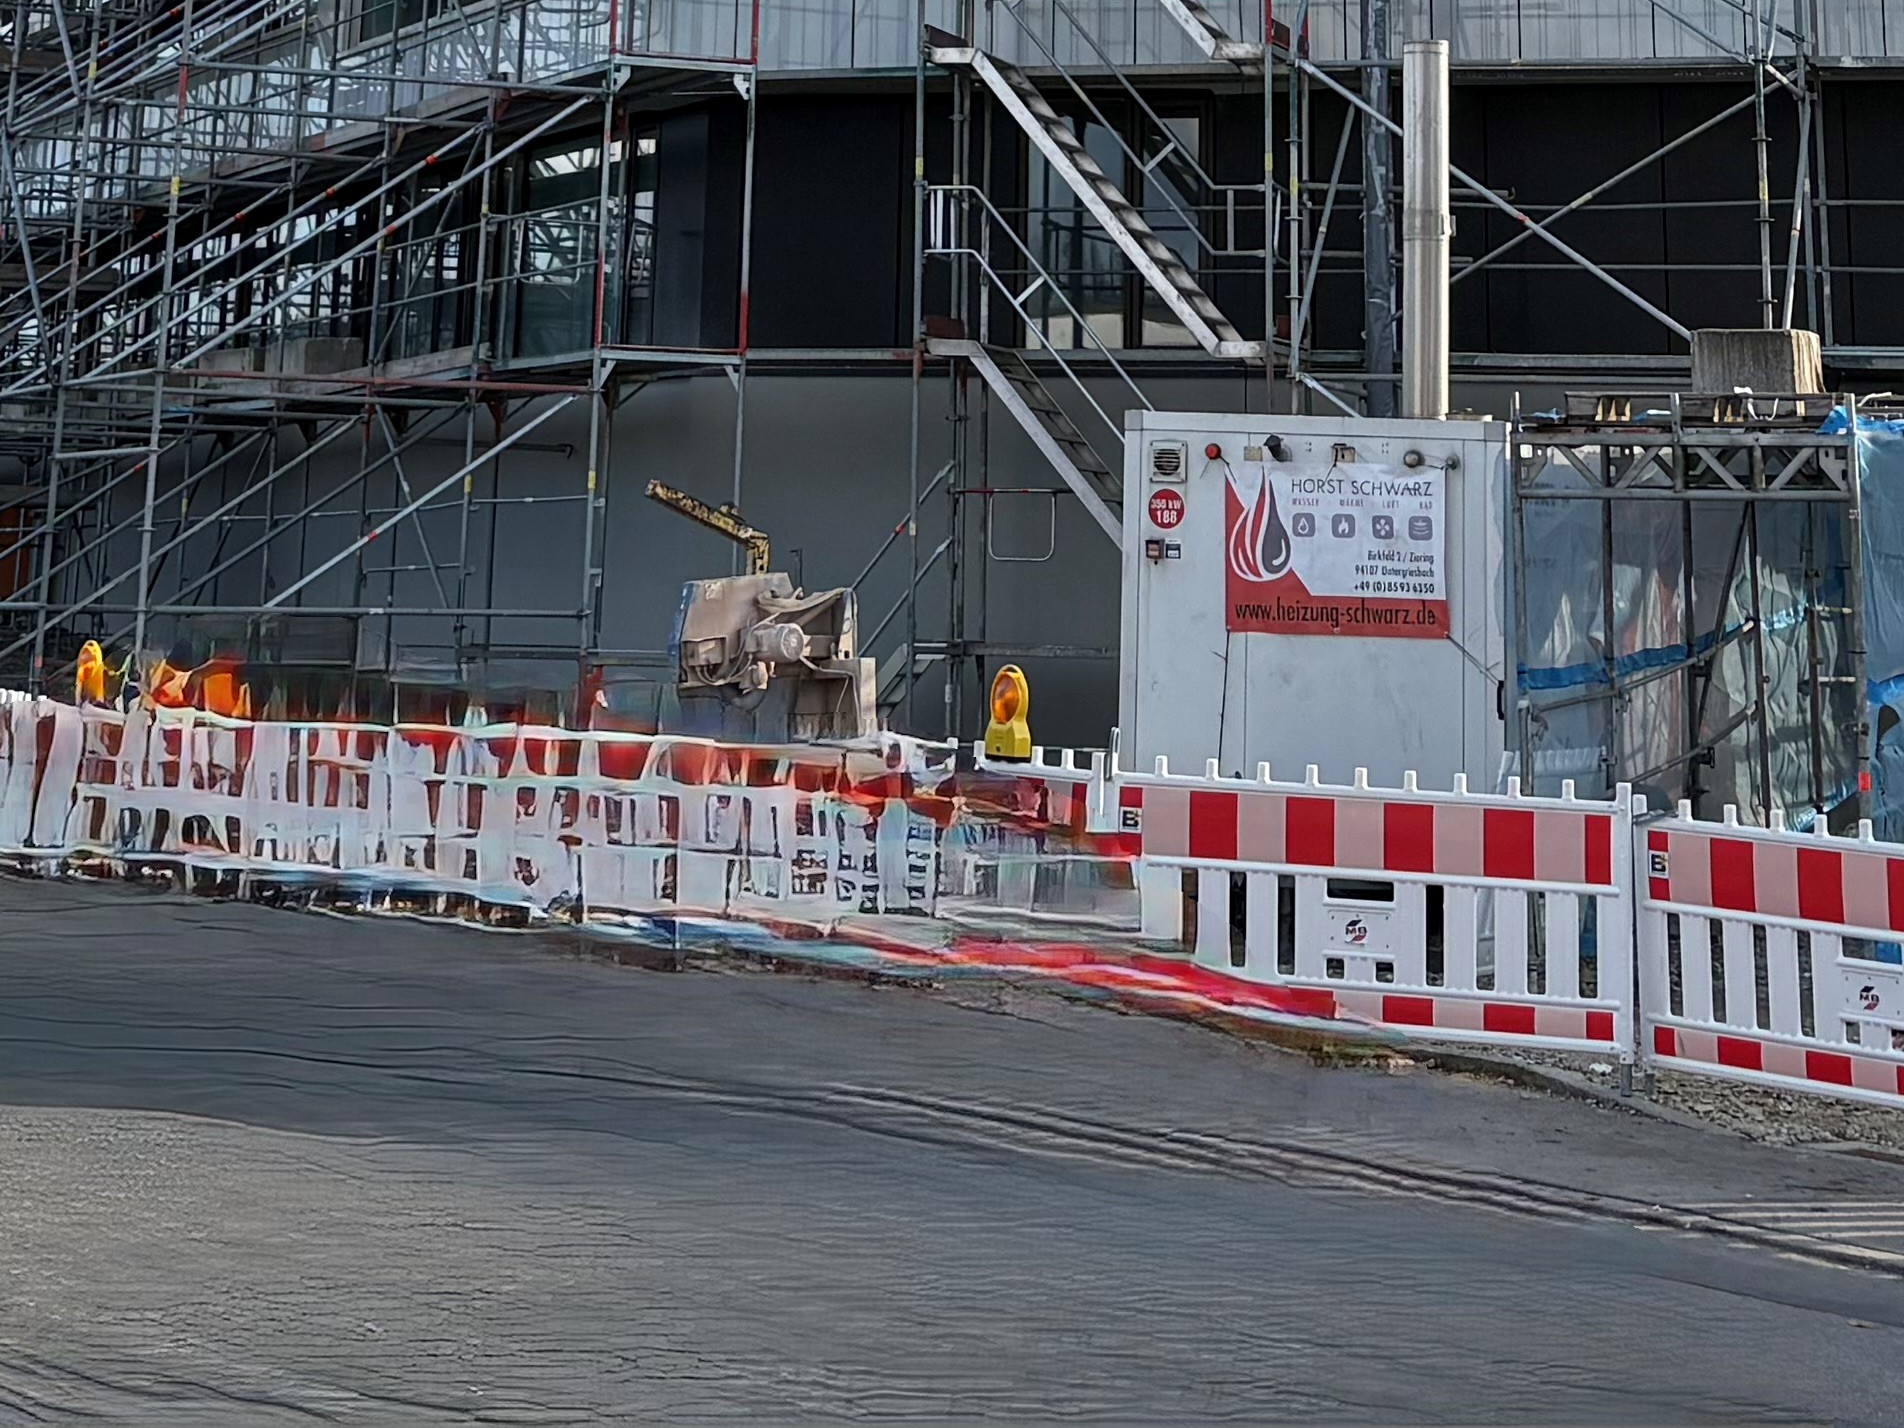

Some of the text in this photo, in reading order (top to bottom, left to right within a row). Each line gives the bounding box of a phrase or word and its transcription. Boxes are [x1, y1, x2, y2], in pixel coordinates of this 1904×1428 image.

[1291, 478, 1433, 497] HORST SCHWARZ
[1235, 596, 1437, 628] www.heizung-schwarz.de
